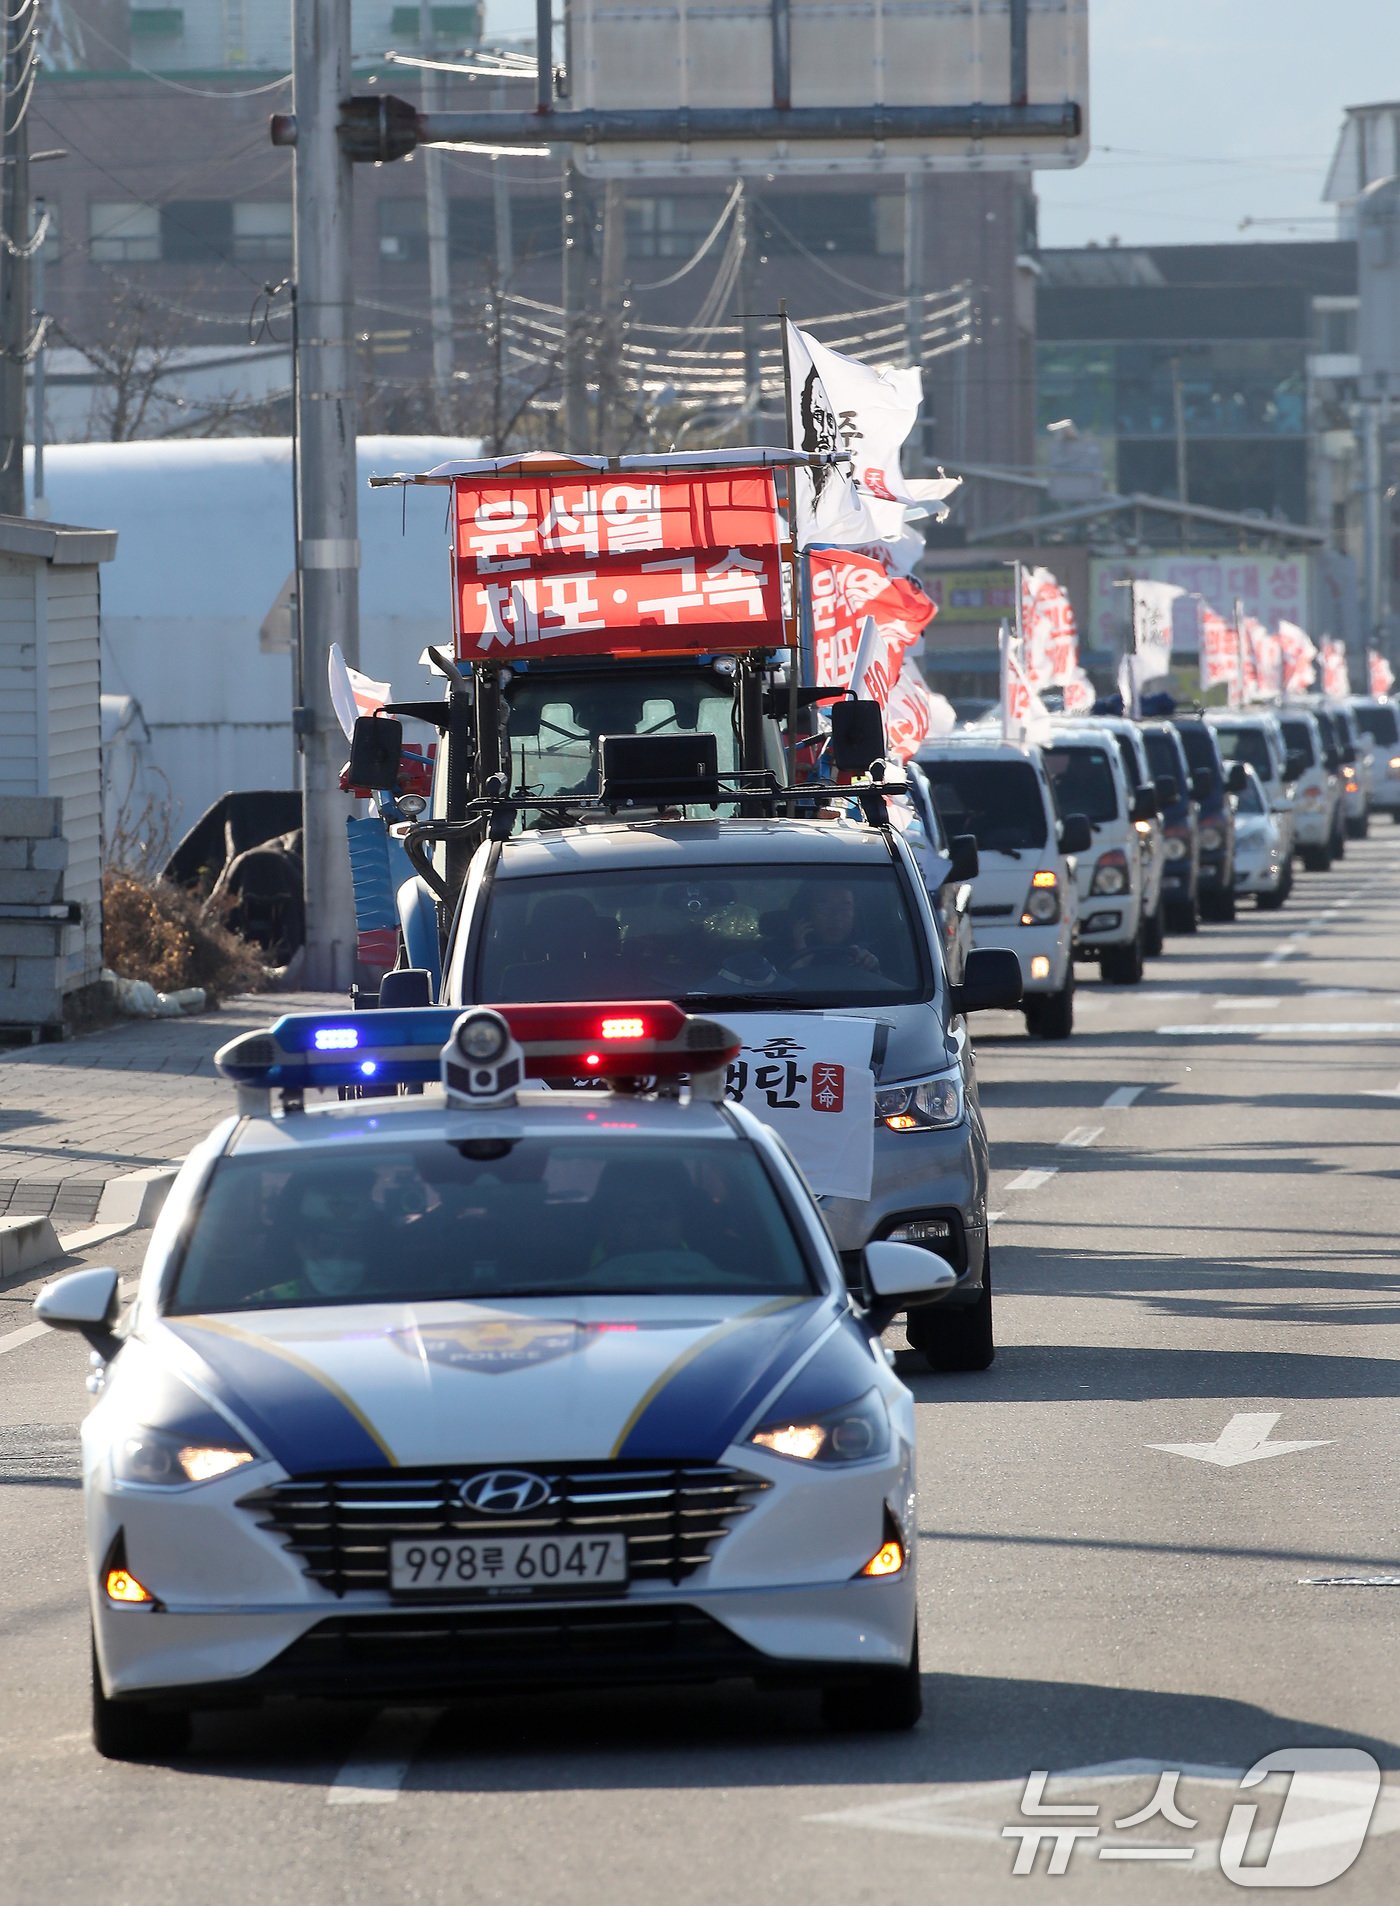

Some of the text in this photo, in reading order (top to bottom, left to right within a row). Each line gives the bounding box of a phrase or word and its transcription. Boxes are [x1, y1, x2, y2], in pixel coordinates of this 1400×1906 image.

[469, 484, 663, 575] 윤석열
[815, 1067, 839, 1109] 天命
[450, 1350, 542, 1362] POLICE
[406, 1541, 611, 1583] 998루 6047
